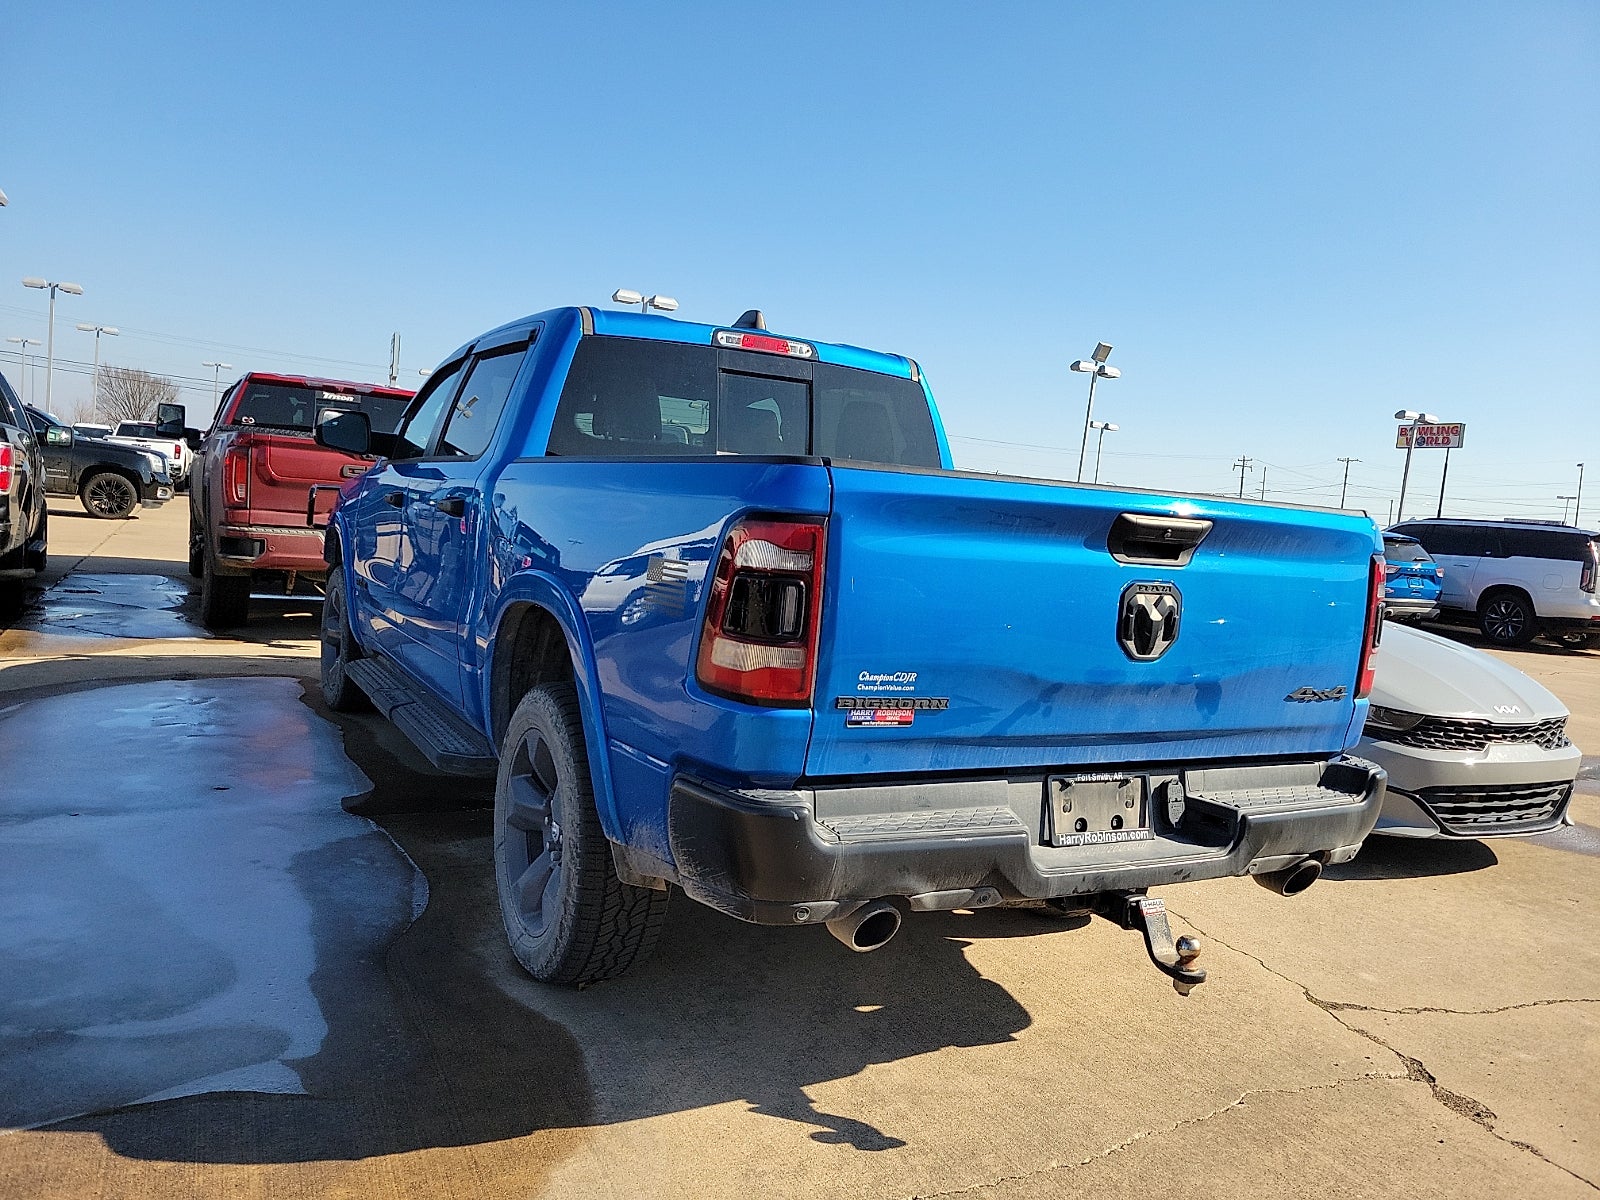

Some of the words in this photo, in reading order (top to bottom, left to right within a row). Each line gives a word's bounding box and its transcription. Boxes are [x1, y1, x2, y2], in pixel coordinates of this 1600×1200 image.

[857, 683, 915, 692] ChampionValue.com
[1113, 771, 1124, 780] AR
[1059, 830, 1149, 846] HarryRobinson.com
